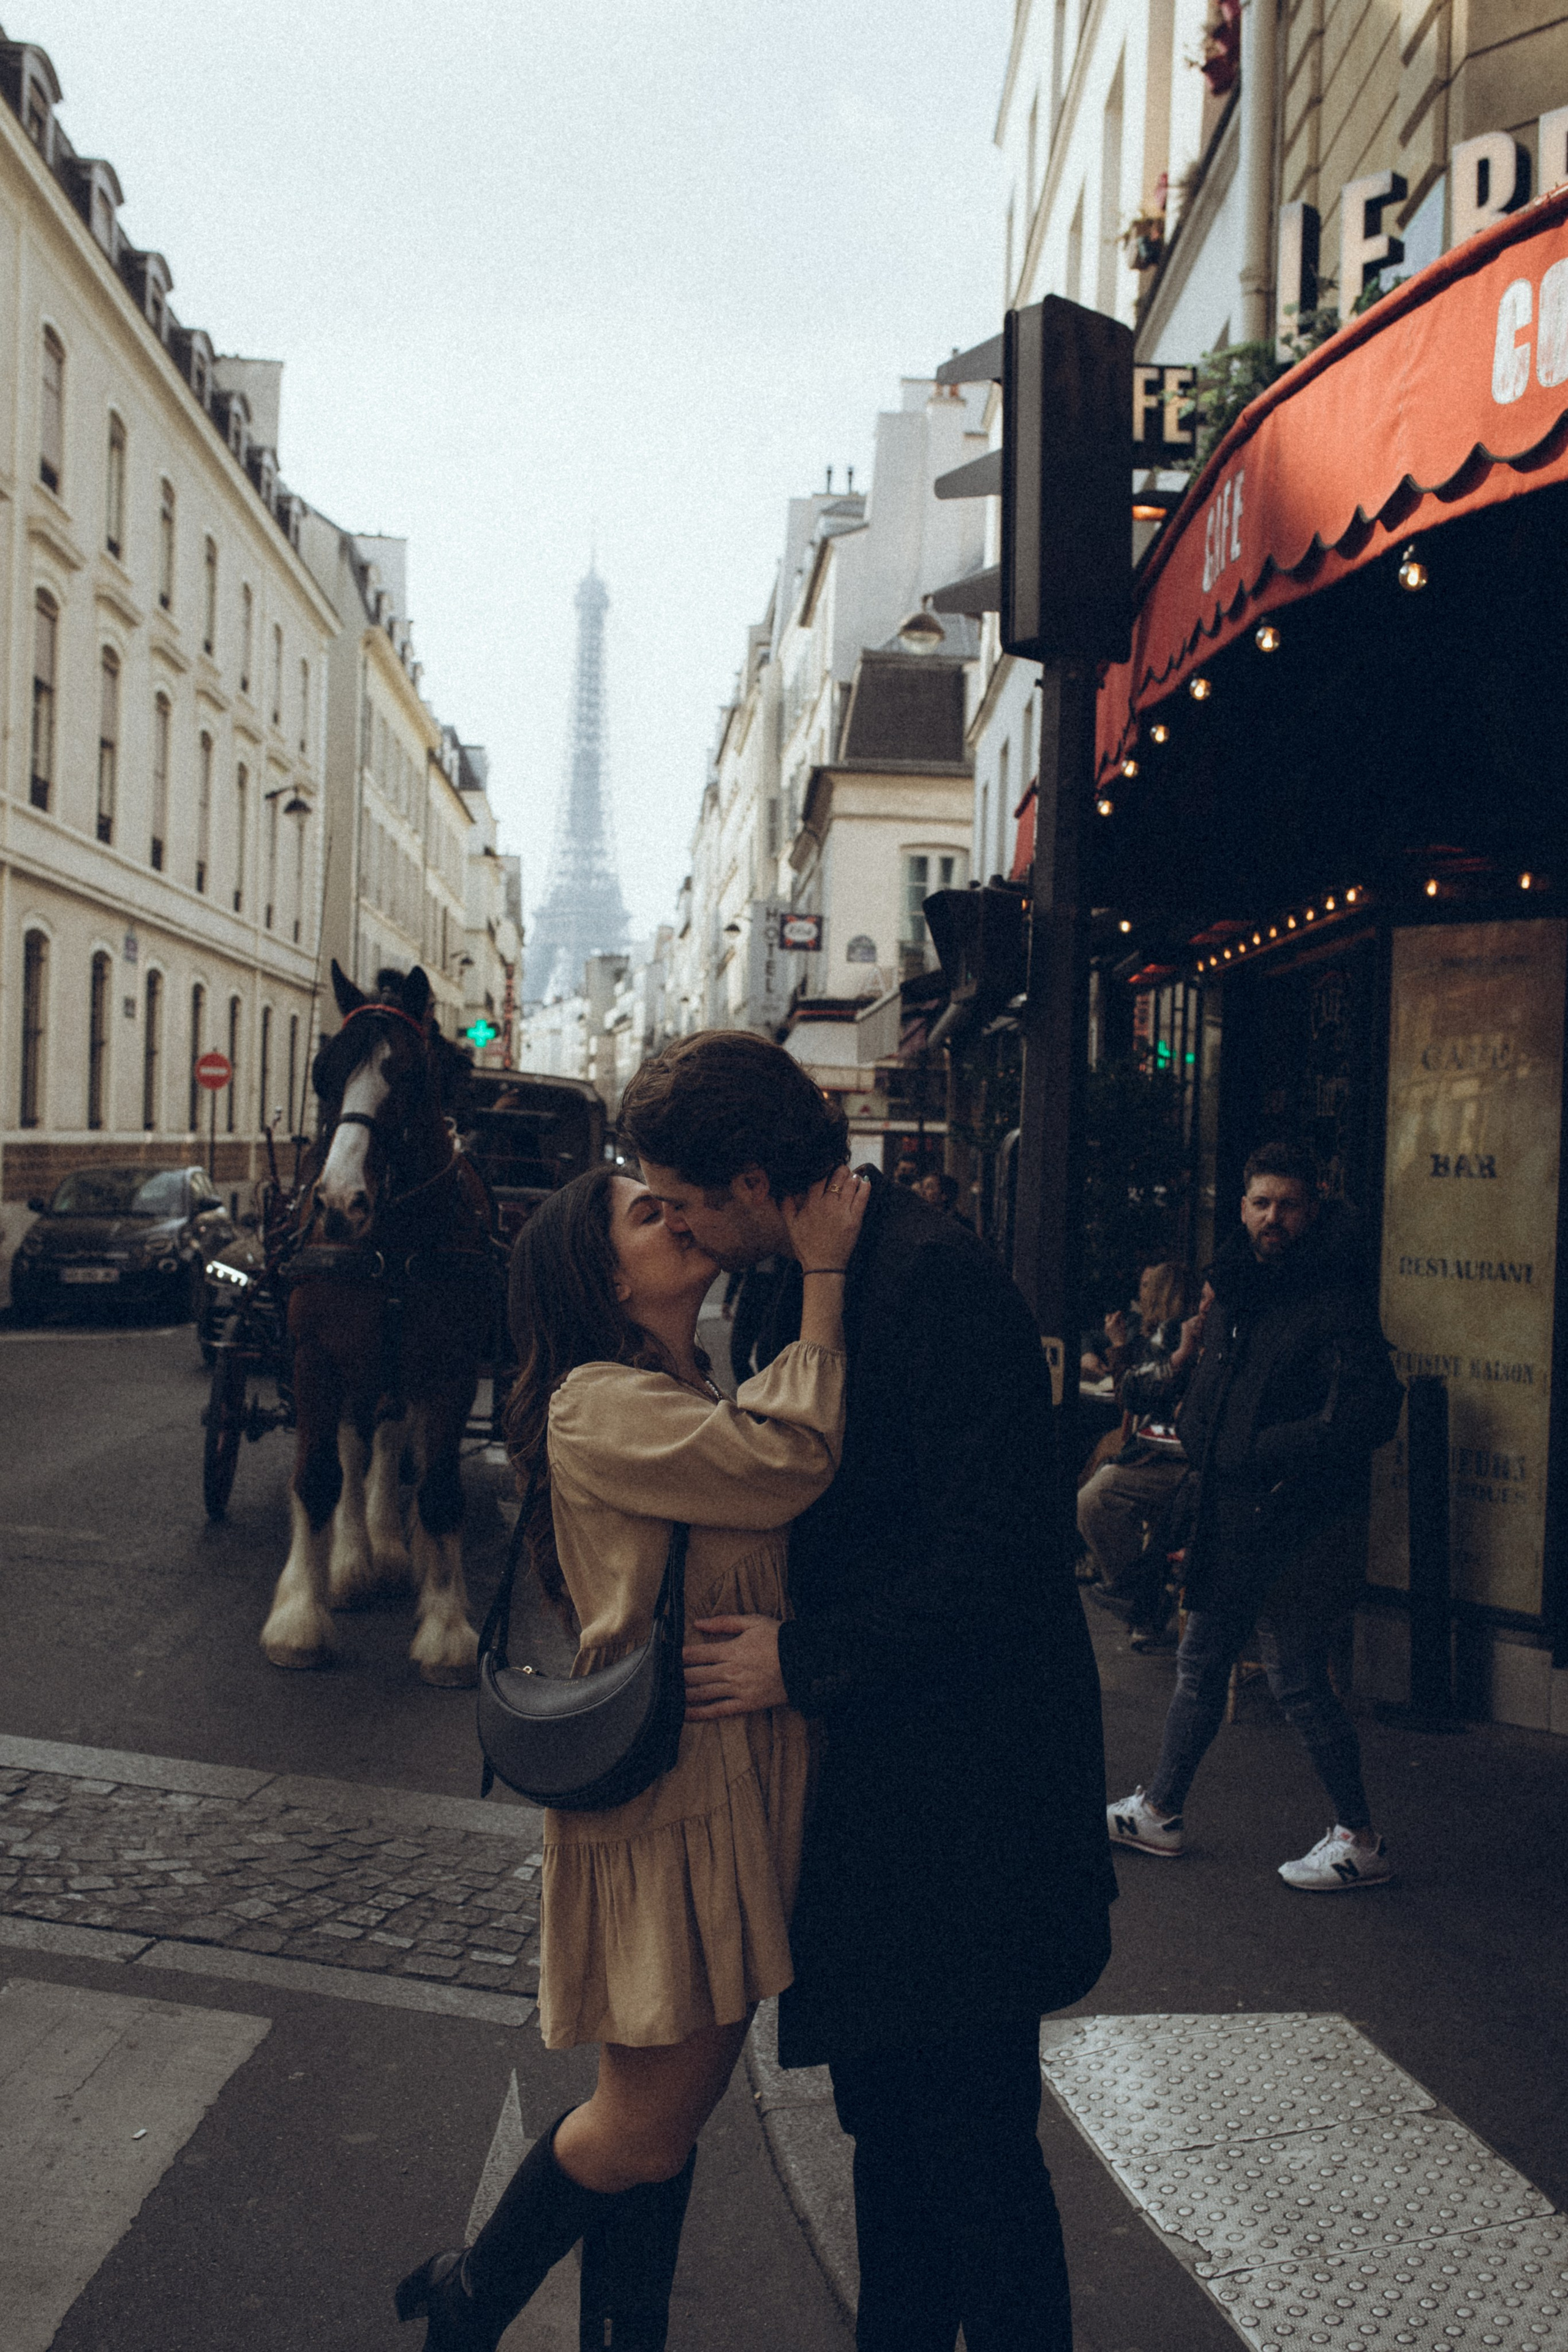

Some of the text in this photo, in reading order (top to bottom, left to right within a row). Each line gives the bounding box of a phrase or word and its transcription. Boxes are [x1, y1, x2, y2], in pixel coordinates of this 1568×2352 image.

[764, 907, 778, 993] HOTEL
[1430, 1154, 1496, 1178] BAR
[1399, 1257, 1532, 1284] RESTAURANT
[1114, 1815, 1139, 1836] N
[1330, 1858, 1360, 1883] N
